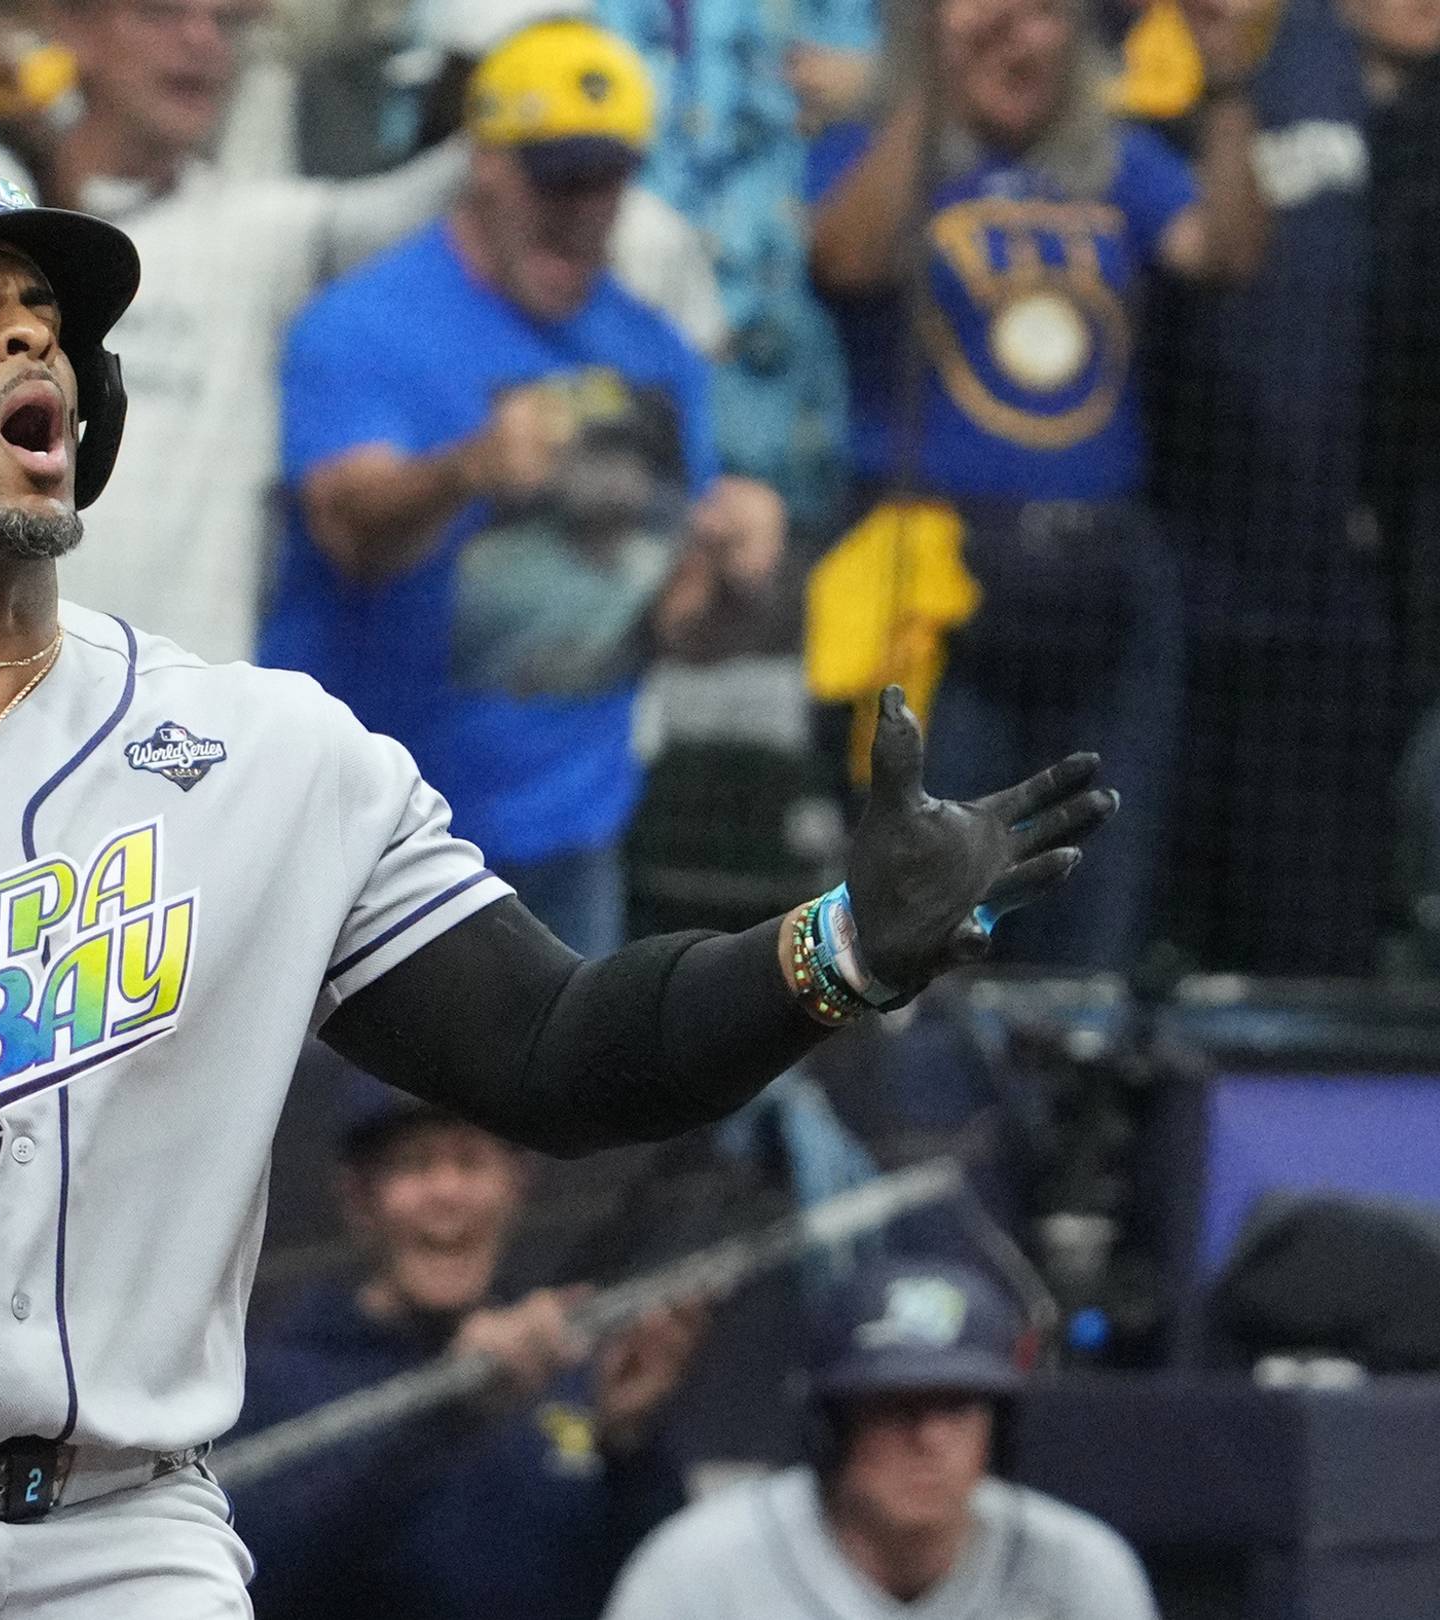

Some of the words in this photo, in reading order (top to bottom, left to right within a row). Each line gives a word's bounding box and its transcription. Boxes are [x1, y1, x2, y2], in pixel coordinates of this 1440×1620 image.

[128, 742, 183, 769] World
[181, 739, 224, 769] Series
[25, 1467, 42, 1502] 2
